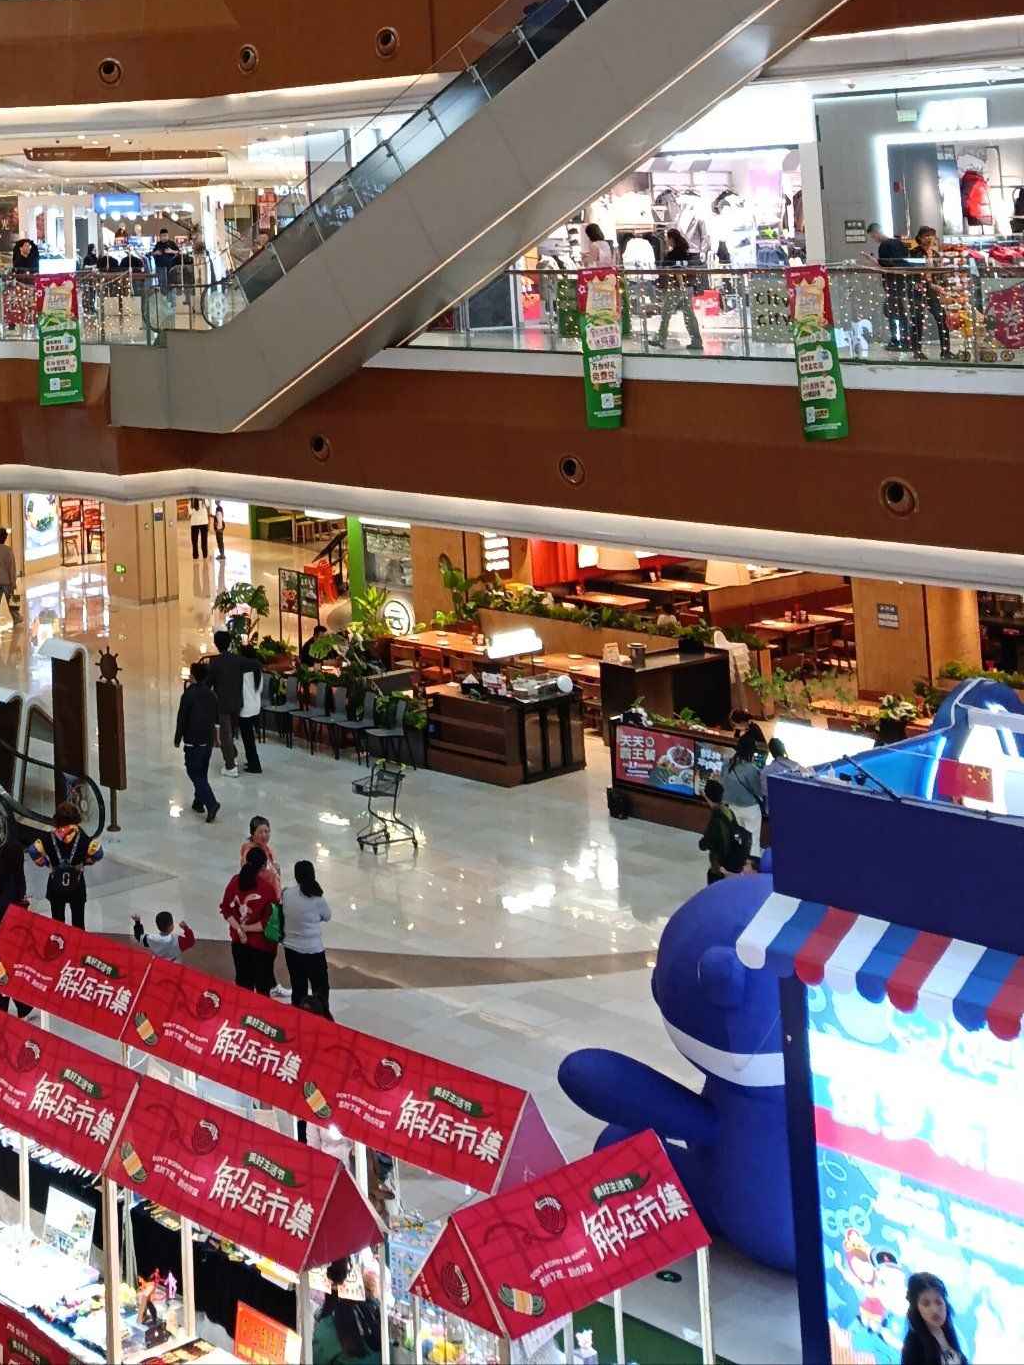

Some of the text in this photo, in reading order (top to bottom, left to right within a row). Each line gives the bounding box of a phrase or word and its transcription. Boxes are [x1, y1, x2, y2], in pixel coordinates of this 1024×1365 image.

[620, 735, 645, 747] 天天
[620, 747, 656, 762] 霸王餐
[54, 960, 132, 1017] 解压市集
[211, 1019, 303, 1085] 解压市集
[26, 1072, 116, 1146] 解压市集
[394, 1090, 505, 1165] 解压市集
[247, 1151, 286, 1181] 美好生活节
[592, 1178, 635, 1200] 美好生活节
[208, 1155, 316, 1241] 解压市集
[580, 1181, 693, 1262] 解压市集
